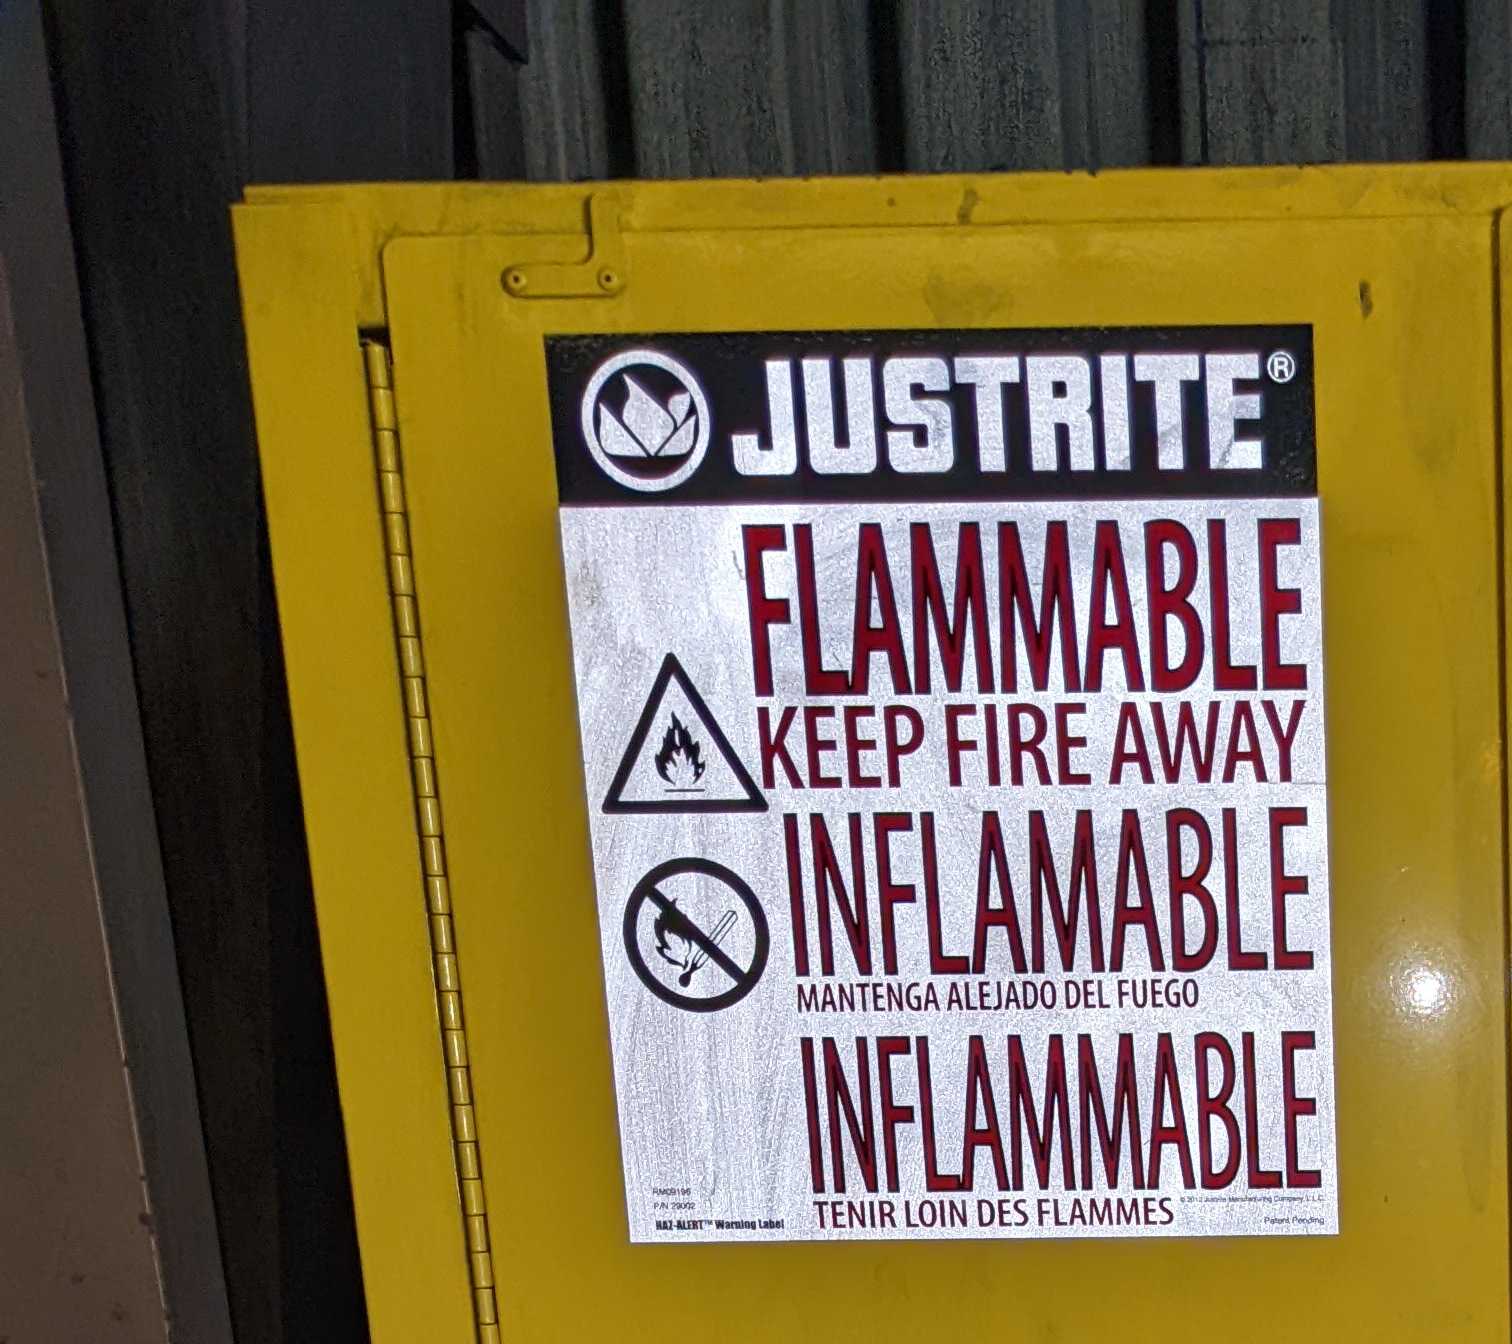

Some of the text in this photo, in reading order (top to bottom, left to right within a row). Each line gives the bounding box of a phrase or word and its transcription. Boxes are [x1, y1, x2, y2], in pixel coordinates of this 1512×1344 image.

[741, 517, 1308, 698] FLAMMABLE
[758, 699, 1307, 790] KEEP FIRE AWAY
[782, 806, 1315, 978] INFLAMABLE
[797, 977, 1200, 1013] MANTENGA ALEJADO DEL FUEGO
[800, 1030, 1323, 1195] INFLAMMABLE
[715, 1219, 756, 1231] Warning
[758, 1218, 785, 1230] Label
[812, 1197, 1175, 1230] TENIR LOIN DES FLAMMES
[1264, 1216, 1325, 1226] Patent Pending
